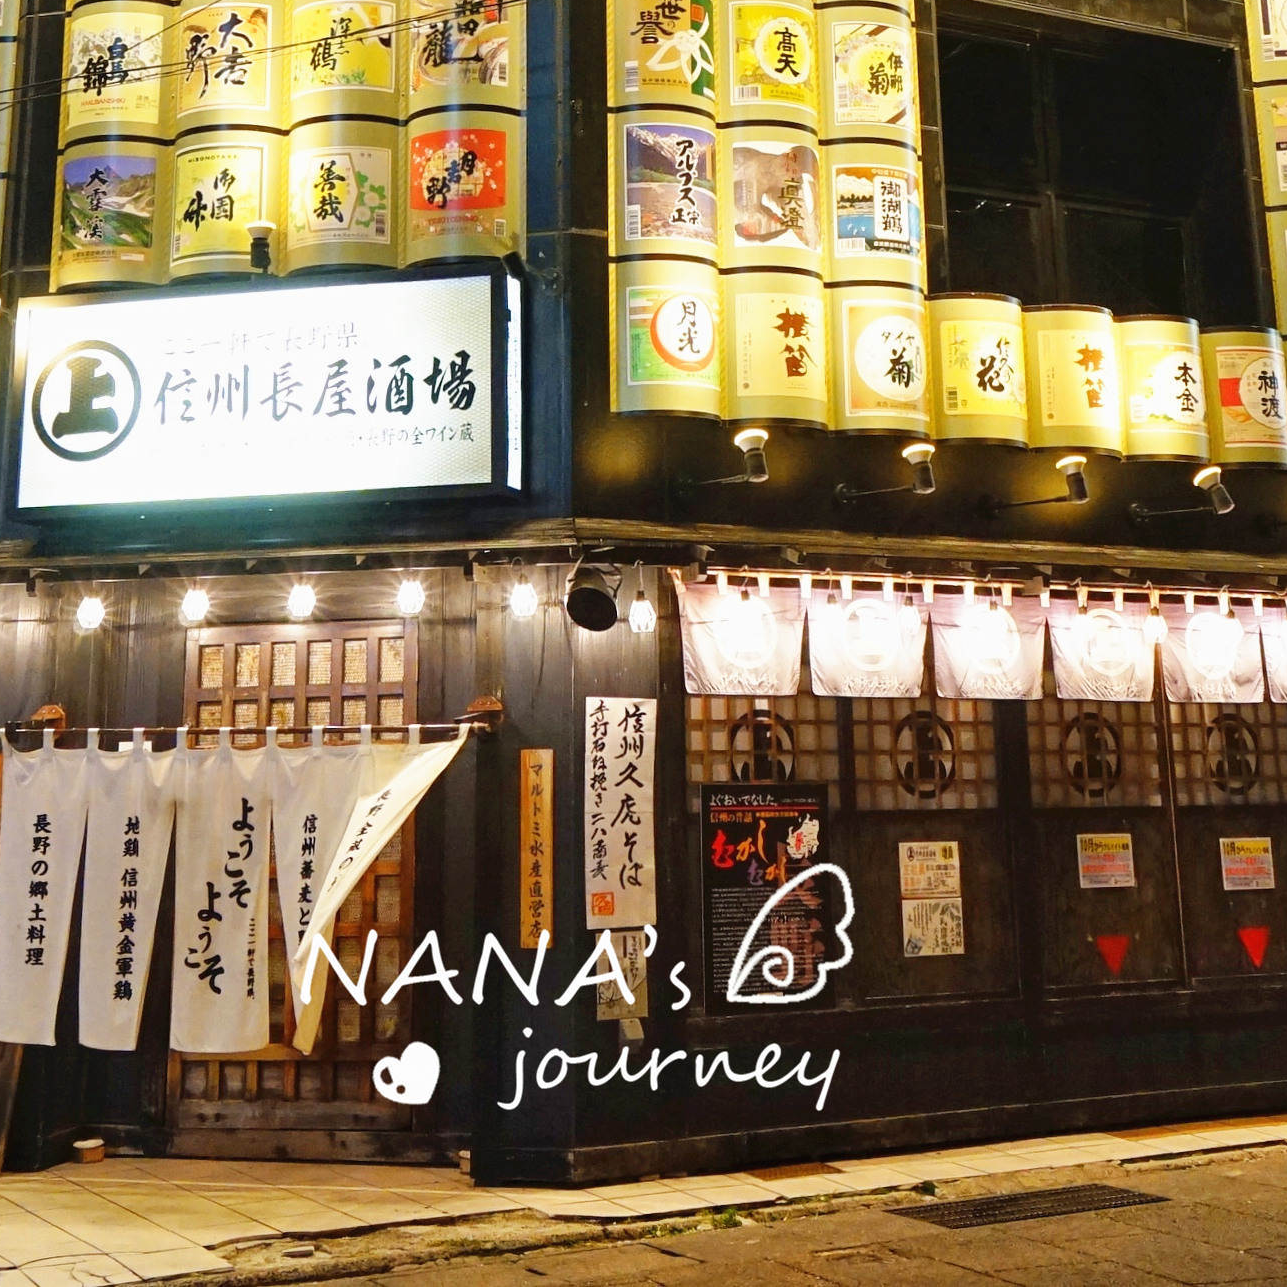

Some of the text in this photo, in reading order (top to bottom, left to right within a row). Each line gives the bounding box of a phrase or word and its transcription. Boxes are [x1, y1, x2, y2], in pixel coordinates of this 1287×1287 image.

[81, 37, 129, 95] 白馬錦
[313, 161, 346, 223] 善哉
[670, 138, 701, 227] アルプス正宗
[677, 299, 701, 354] 月光
[154, 349, 478, 425] 信州長屋酒場
[1174, 362, 1199, 413] 本金
[1257, 369, 1284, 421] 神渡
[224, 797, 256, 910] ようこそ
[25, 813, 52, 967] 長野の郷土料理
[184, 880, 225, 996] ようこそ
